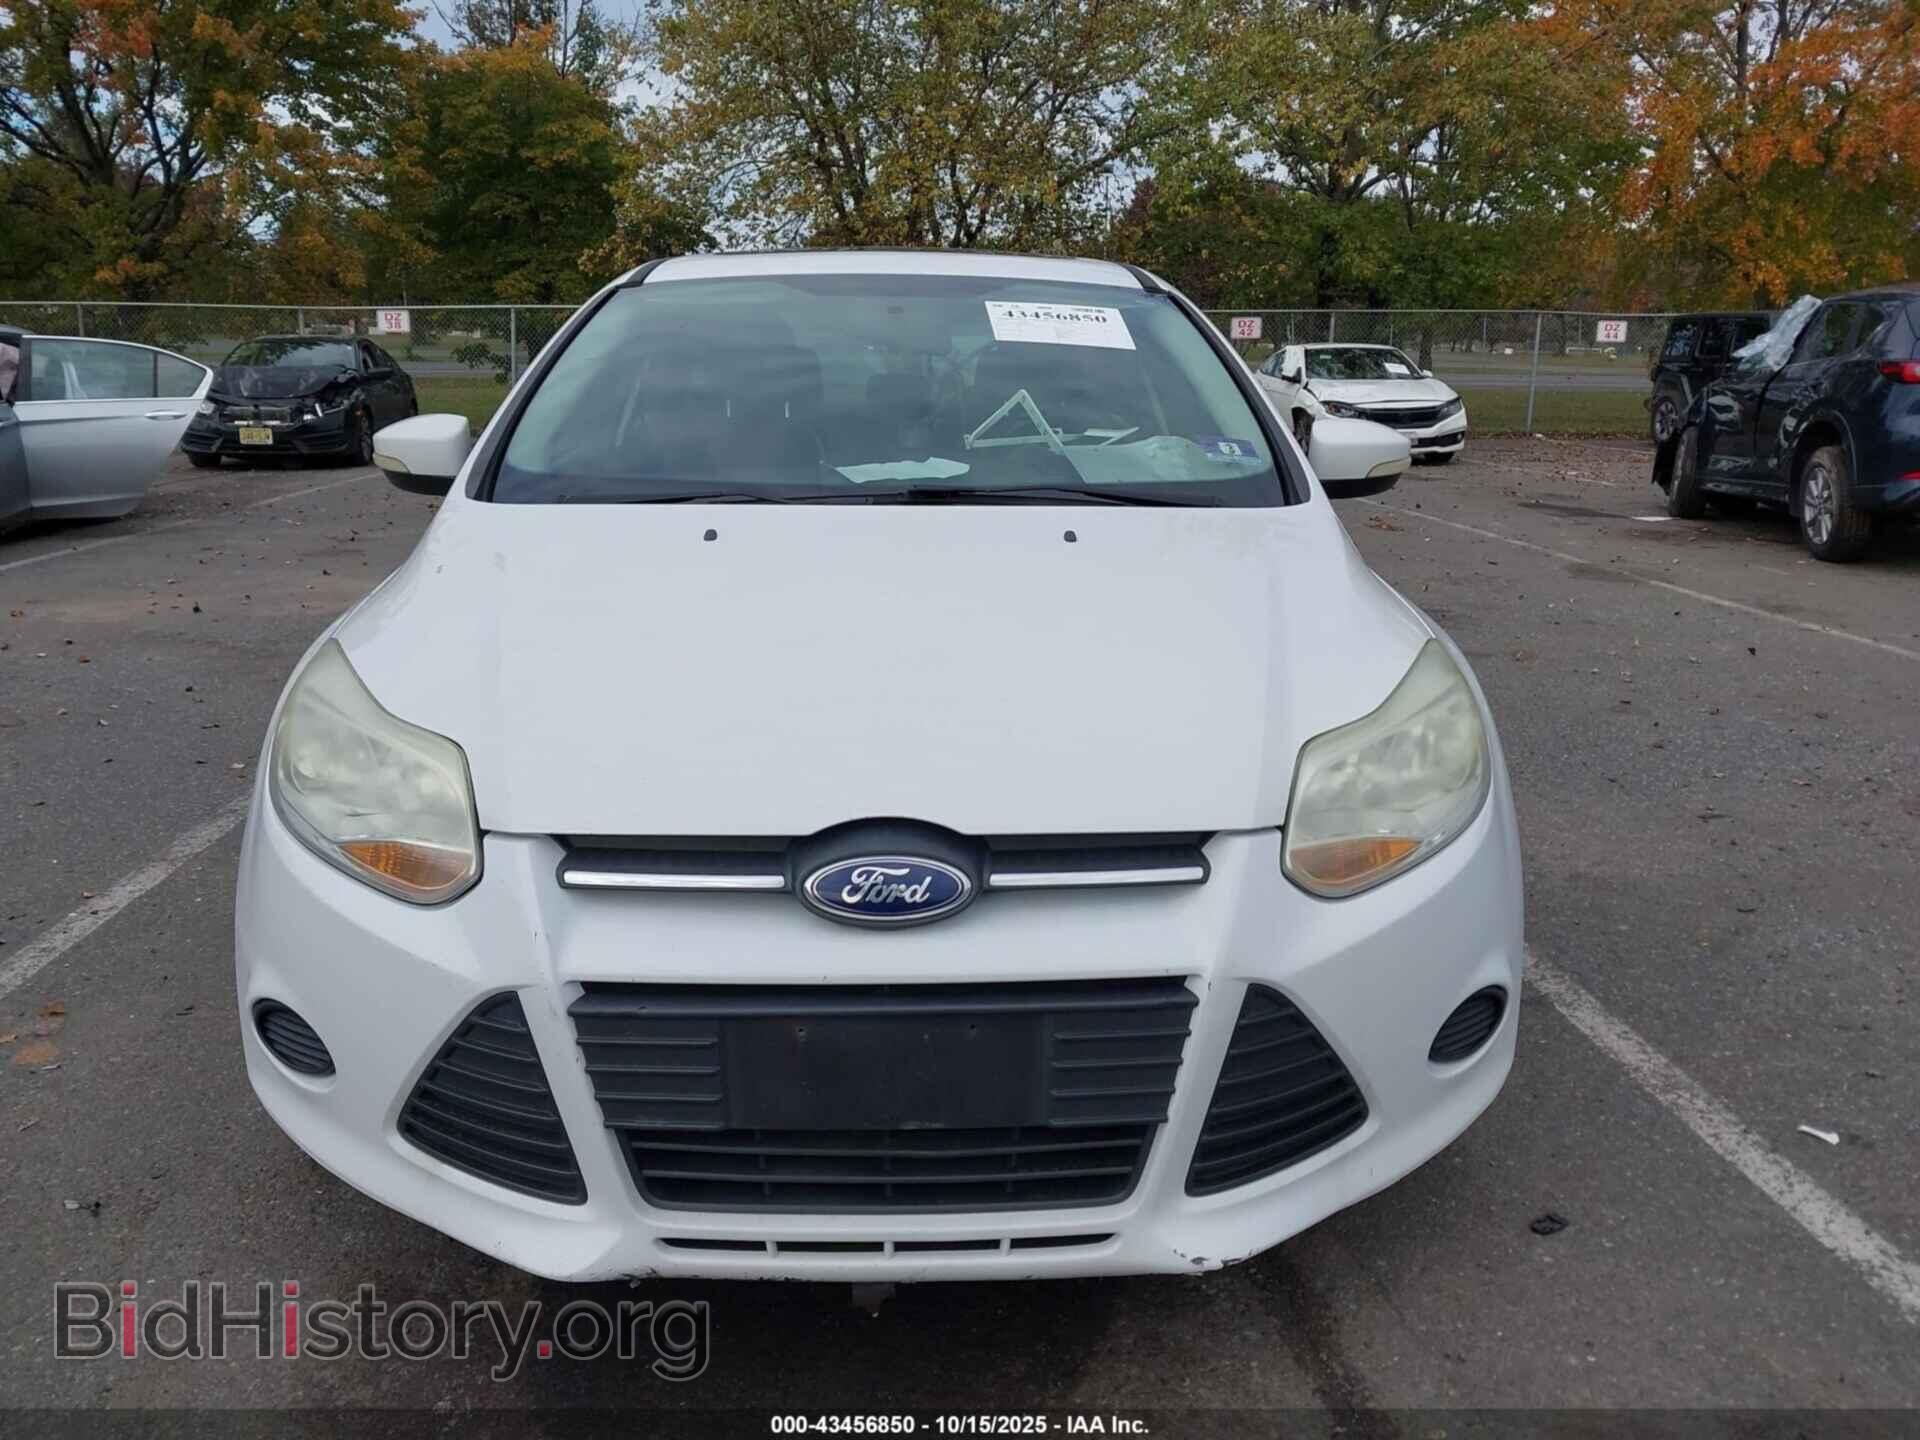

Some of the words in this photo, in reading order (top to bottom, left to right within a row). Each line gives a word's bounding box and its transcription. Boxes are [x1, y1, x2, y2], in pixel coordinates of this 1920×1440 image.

[384, 312, 401, 320] DZ
[1238, 320, 1255, 328] DZ
[1604, 331, 1618, 339] 44
[841, 866, 932, 904] Ford
